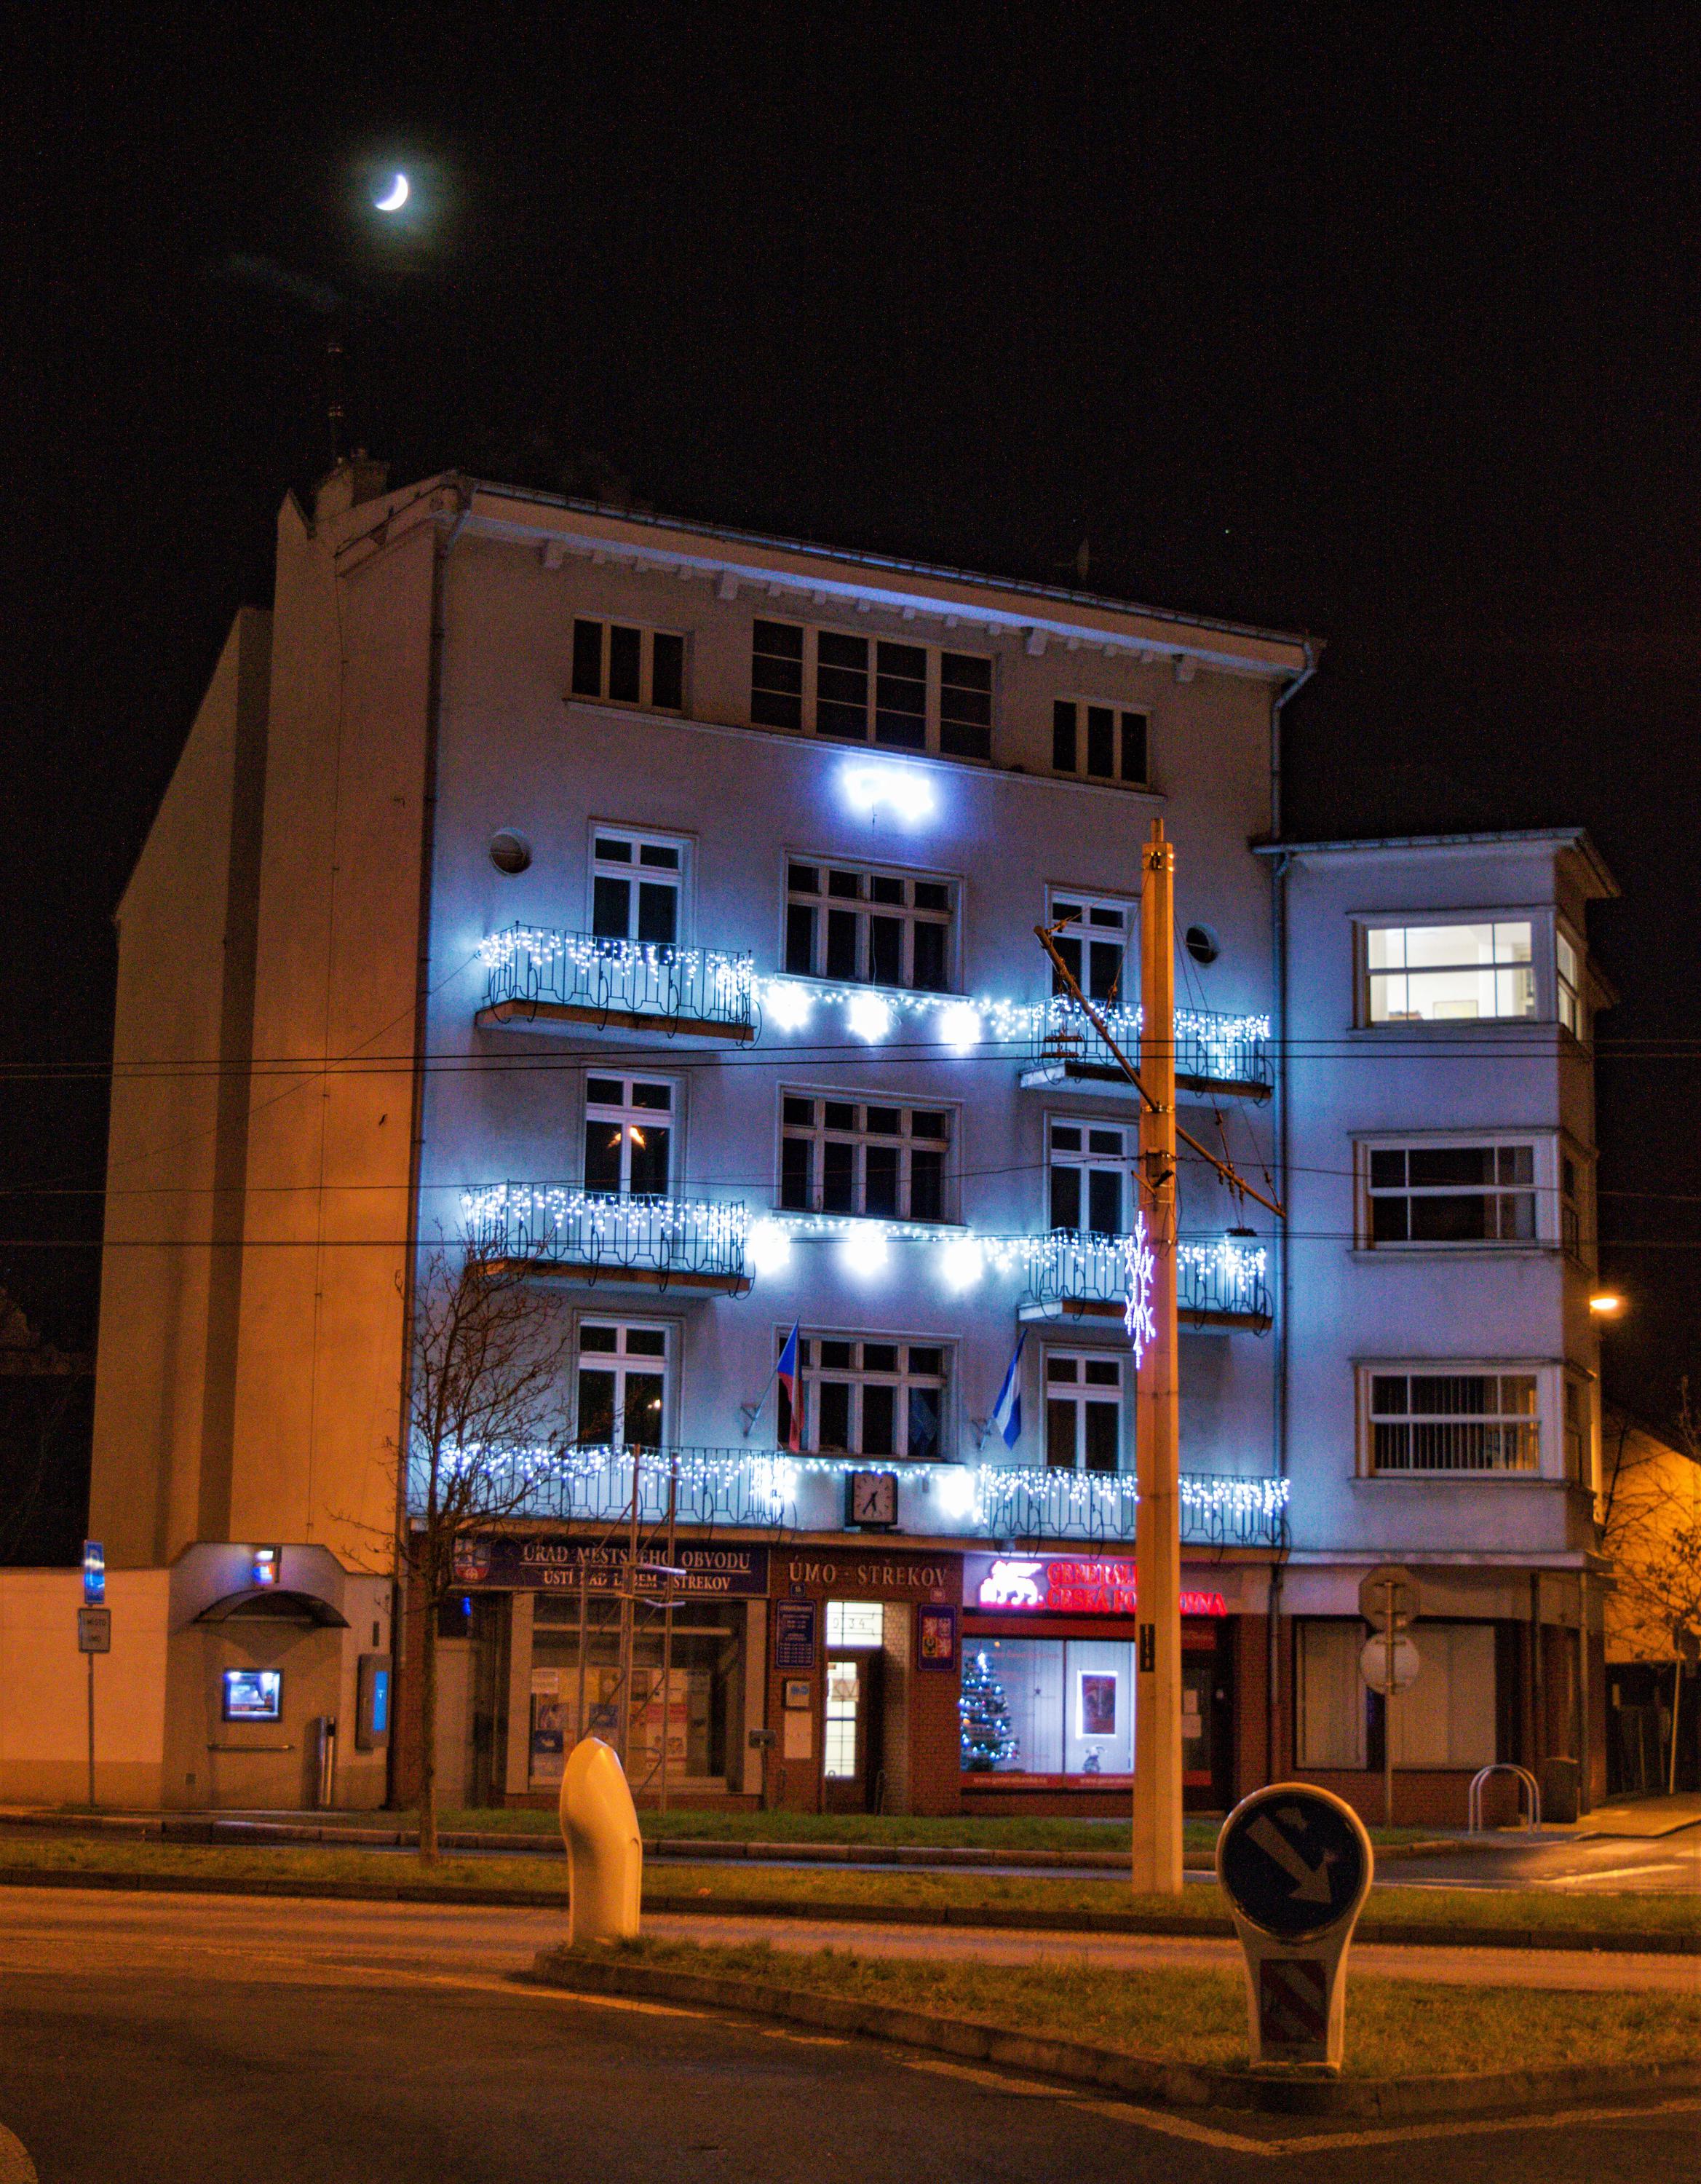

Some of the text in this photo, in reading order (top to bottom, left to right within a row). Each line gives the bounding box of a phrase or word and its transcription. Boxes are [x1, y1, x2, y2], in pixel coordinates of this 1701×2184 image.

[681, 1550, 751, 1570] OBVODU
[788, 1555, 836, 1583] ÚMO
[857, 1558, 947, 1587] STŘEKOV
[613, 1572, 657, 1588] LEM
[1047, 1562, 1138, 1585] GENERALI
[1047, 1583, 1229, 1616] ČESKÁ POOVNA
